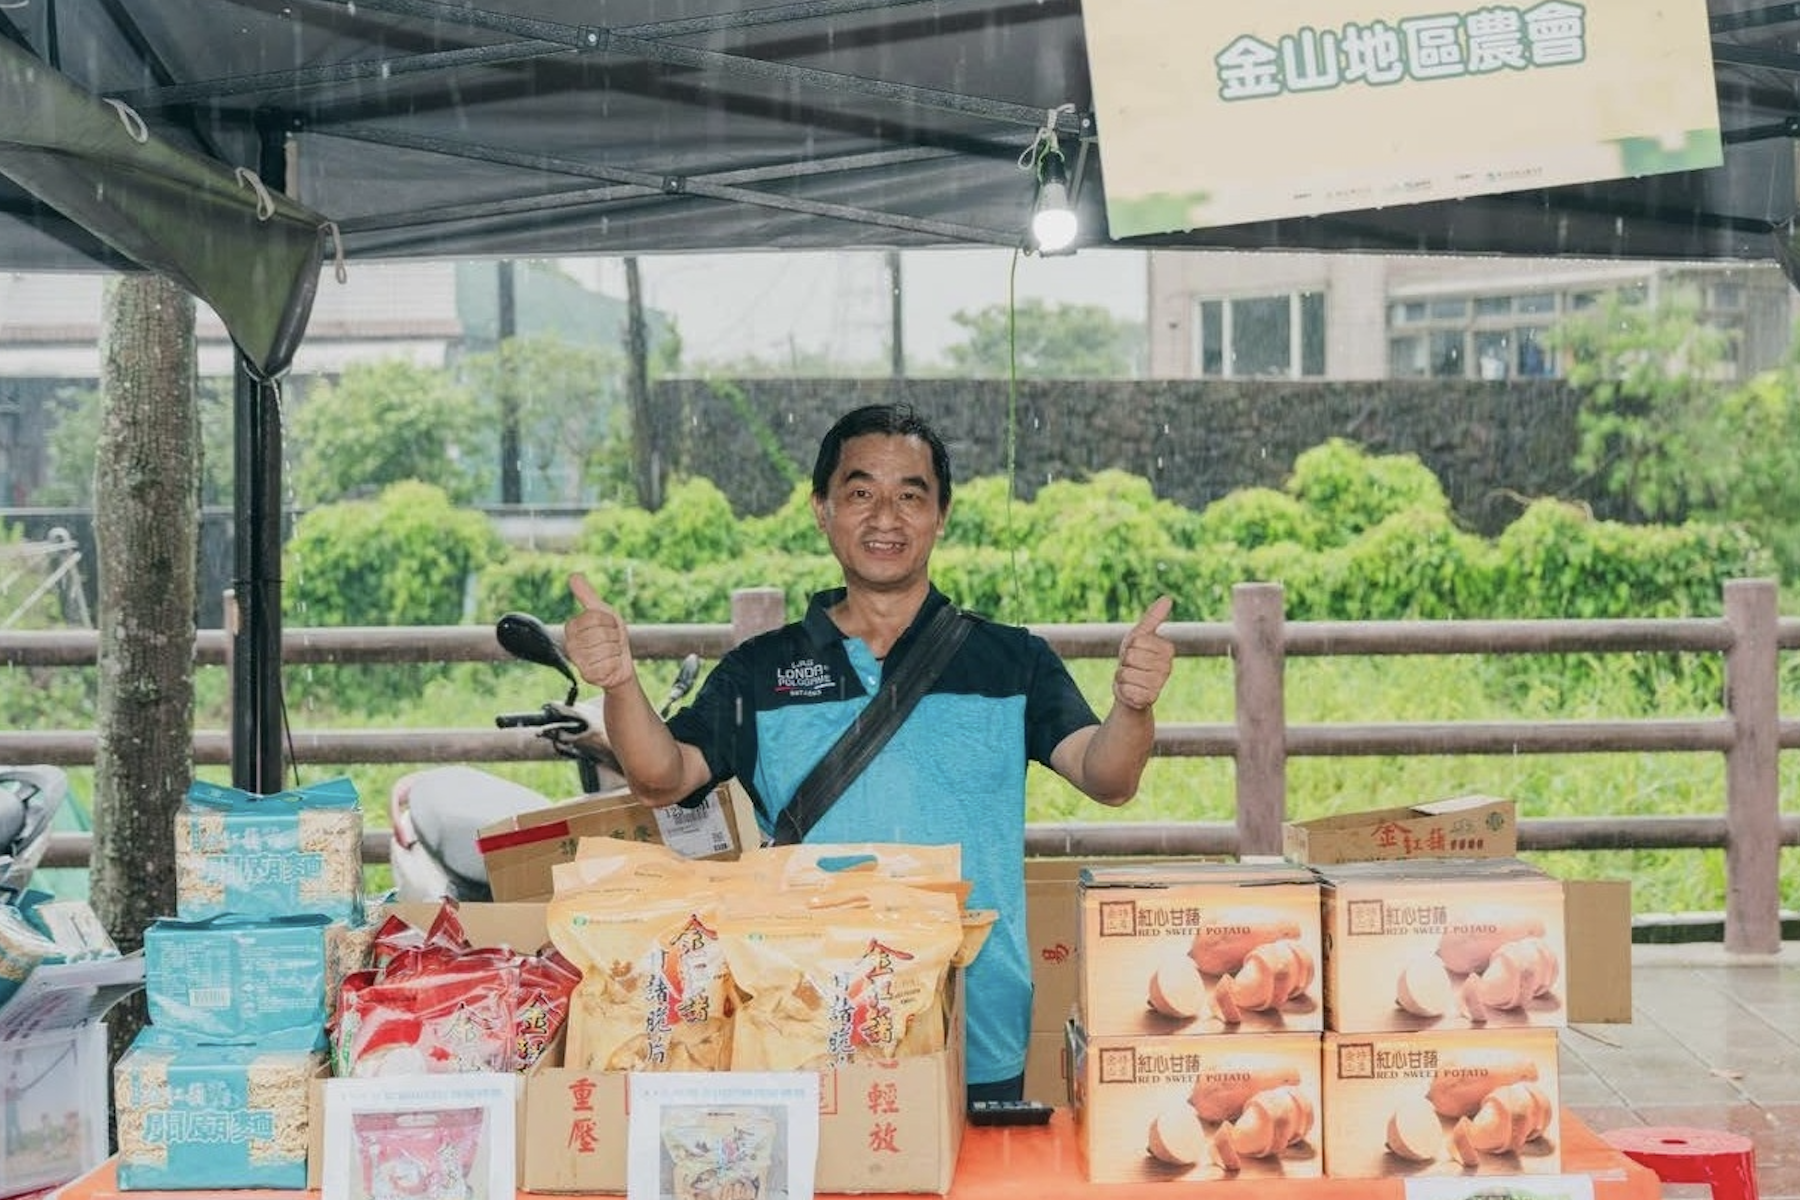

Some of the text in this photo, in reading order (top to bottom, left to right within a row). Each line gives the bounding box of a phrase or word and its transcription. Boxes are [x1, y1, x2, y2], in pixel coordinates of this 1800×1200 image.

[1215, 0, 1586, 101] 金山地區農會
[1138, 926, 1251, 936] RED SWEET POTATO
[1386, 925, 1497, 935] RED SWEET POTATO
[1138, 1073, 1251, 1083] RED SWEET POTATO
[1376, 1068, 1489, 1078] RED SWEET POTATO
[568, 1078, 599, 1153] 重壓
